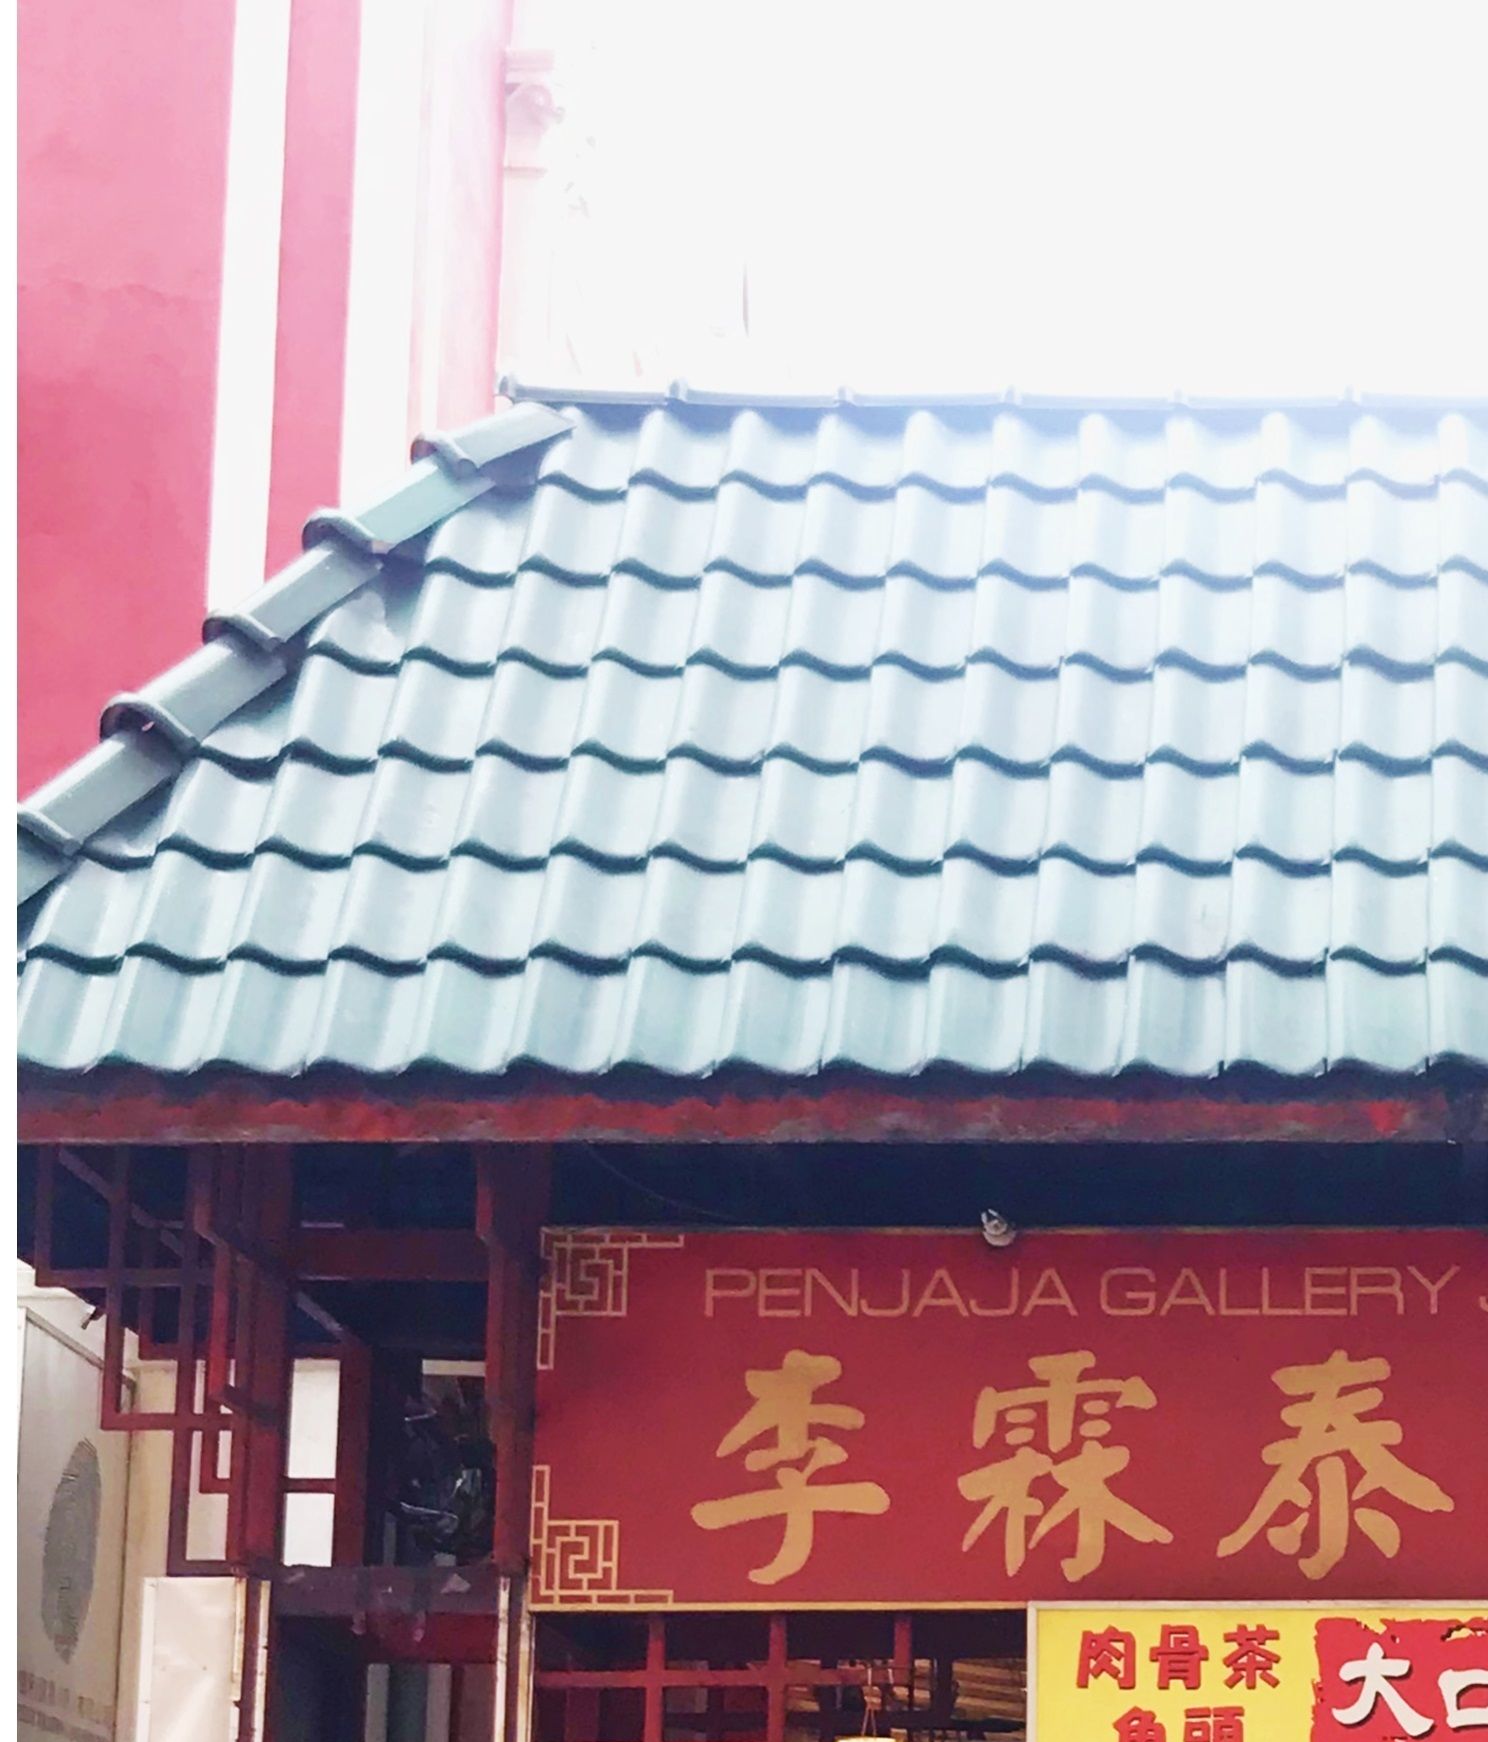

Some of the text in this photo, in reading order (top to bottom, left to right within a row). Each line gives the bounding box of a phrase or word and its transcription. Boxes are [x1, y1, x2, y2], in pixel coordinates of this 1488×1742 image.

[704, 1266, 1078, 1318] PENJAJA
[1100, 1265, 1461, 1317] GALLERY
[1076, 1624, 1281, 1690] 肉骨茶
